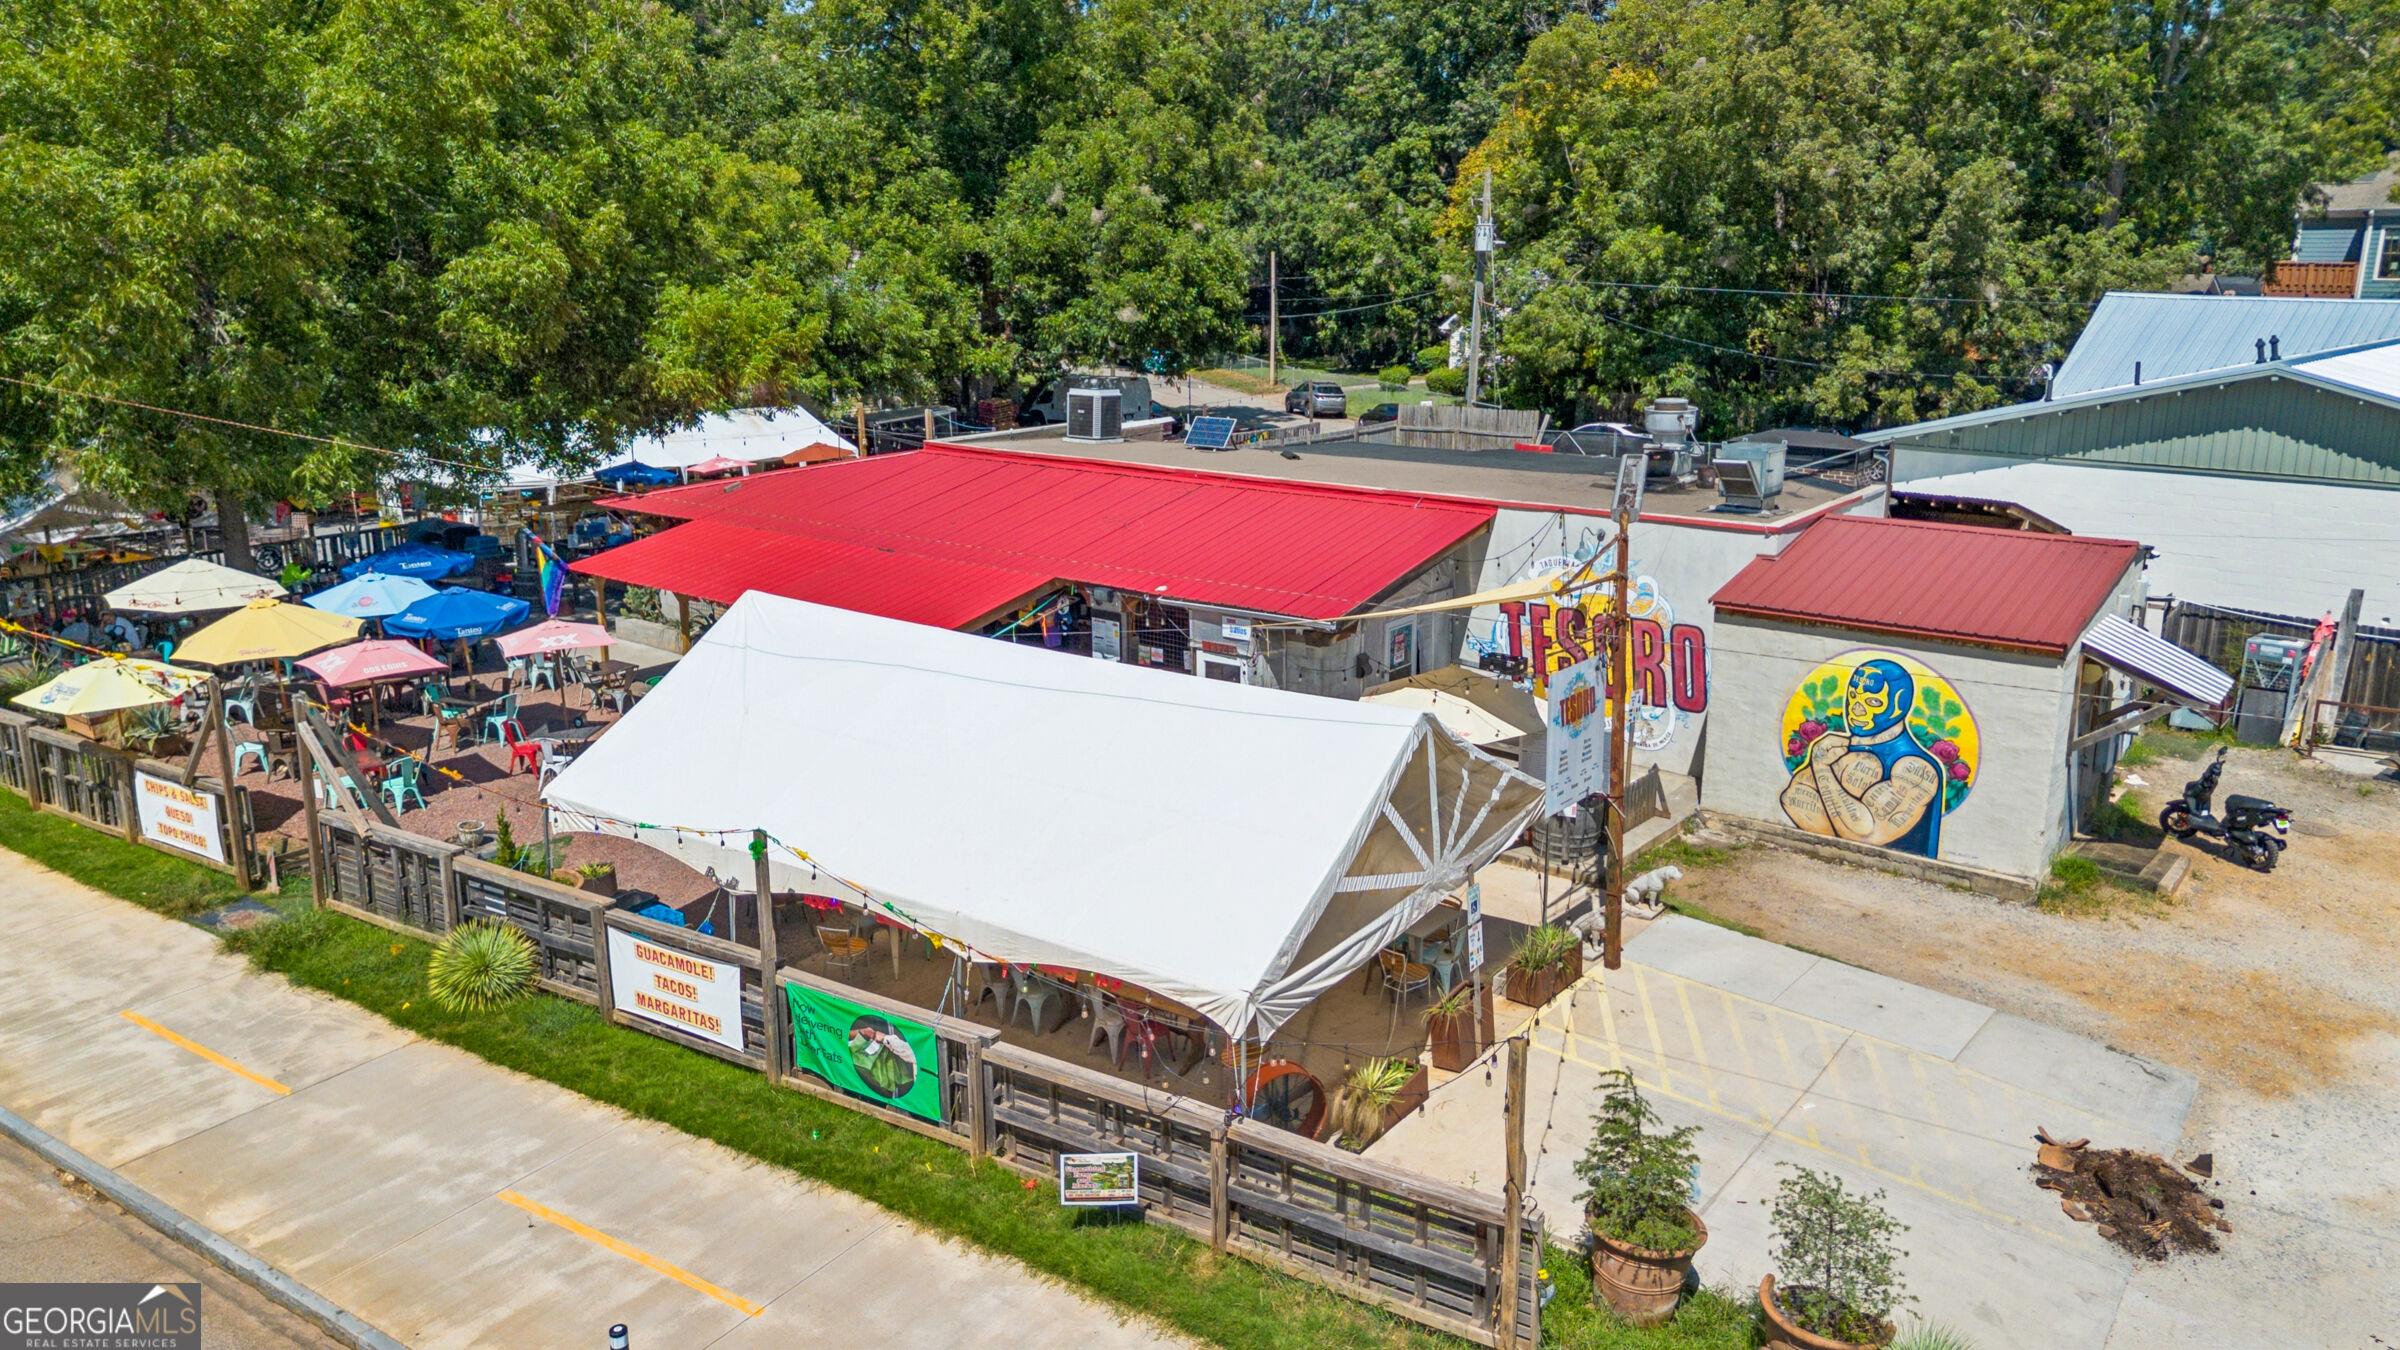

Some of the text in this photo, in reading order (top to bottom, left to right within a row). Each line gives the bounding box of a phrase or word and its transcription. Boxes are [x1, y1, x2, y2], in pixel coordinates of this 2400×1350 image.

[455, 627, 482, 635] Tanteo
[537, 633, 580, 648] XX
[1559, 686, 1596, 728] TESORO
[145, 780, 169, 798] CHIPS
[158, 822, 178, 838] TOPO
[635, 943, 713, 980] GUACAMOLE!
[654, 974, 697, 1000] TACOS!
[636, 992, 719, 1033] MARGARITAS!
